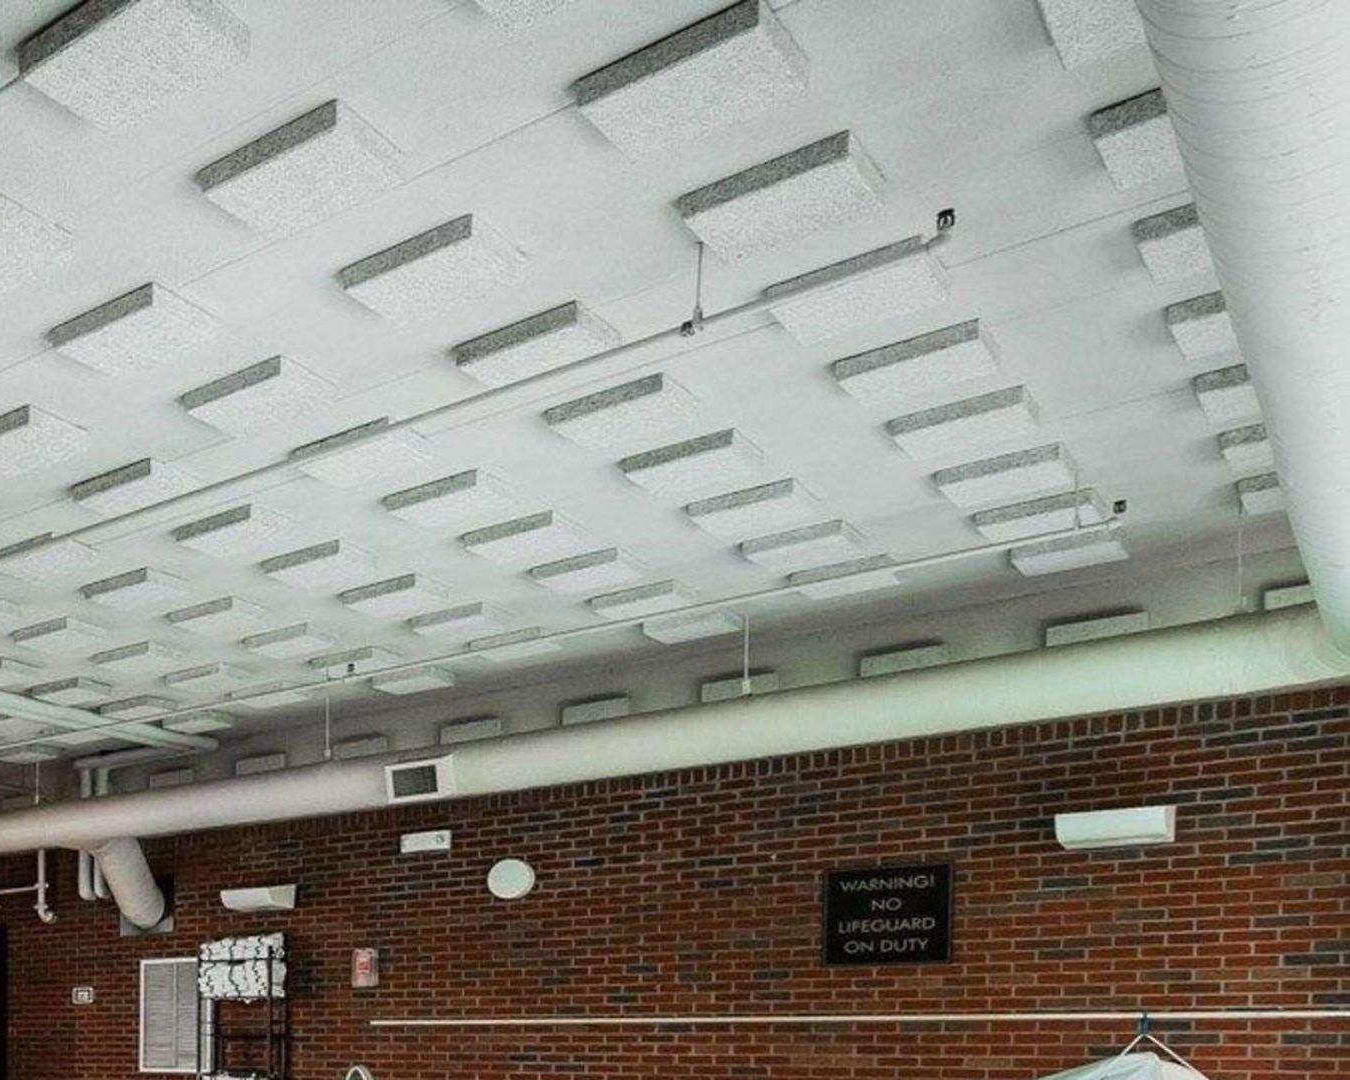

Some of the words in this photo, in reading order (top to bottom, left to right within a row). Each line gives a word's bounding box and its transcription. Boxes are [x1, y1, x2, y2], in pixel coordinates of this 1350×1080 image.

[839, 874, 935, 892] WARNING!
[870, 897, 902, 912] NO
[838, 917, 936, 935] LIFEGUARD
[843, 940, 874, 955] ON
[880, 937, 929, 953] DUTY
